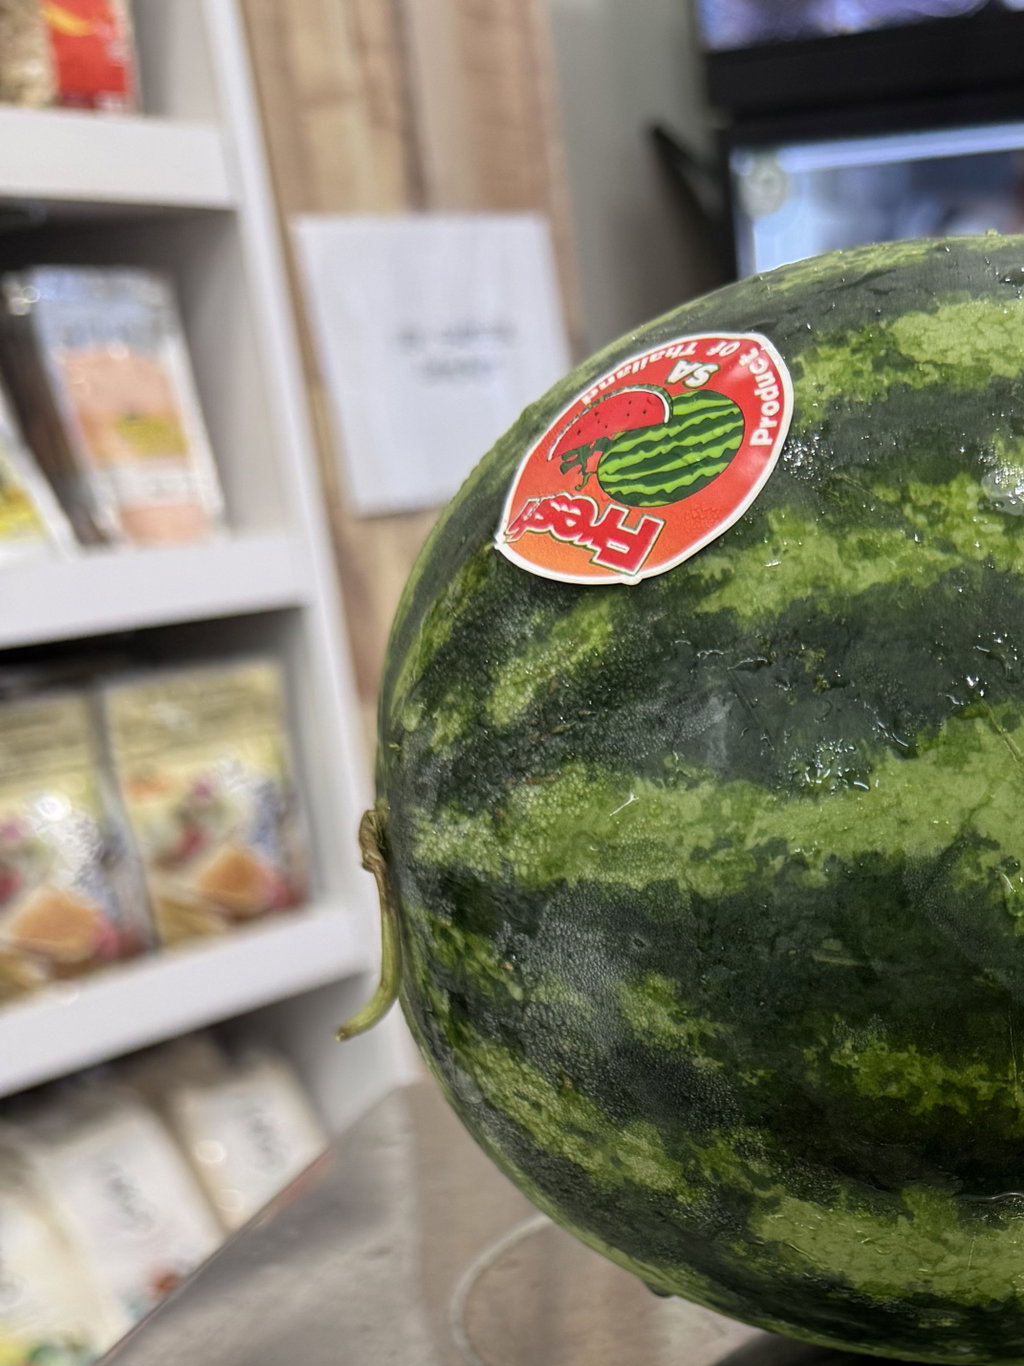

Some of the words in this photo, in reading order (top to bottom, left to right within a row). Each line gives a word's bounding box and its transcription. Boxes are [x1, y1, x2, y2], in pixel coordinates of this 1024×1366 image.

[581, 339, 699, 405] Thailand
[664, 359, 720, 388] SA
[738, 346, 781, 447] Product
